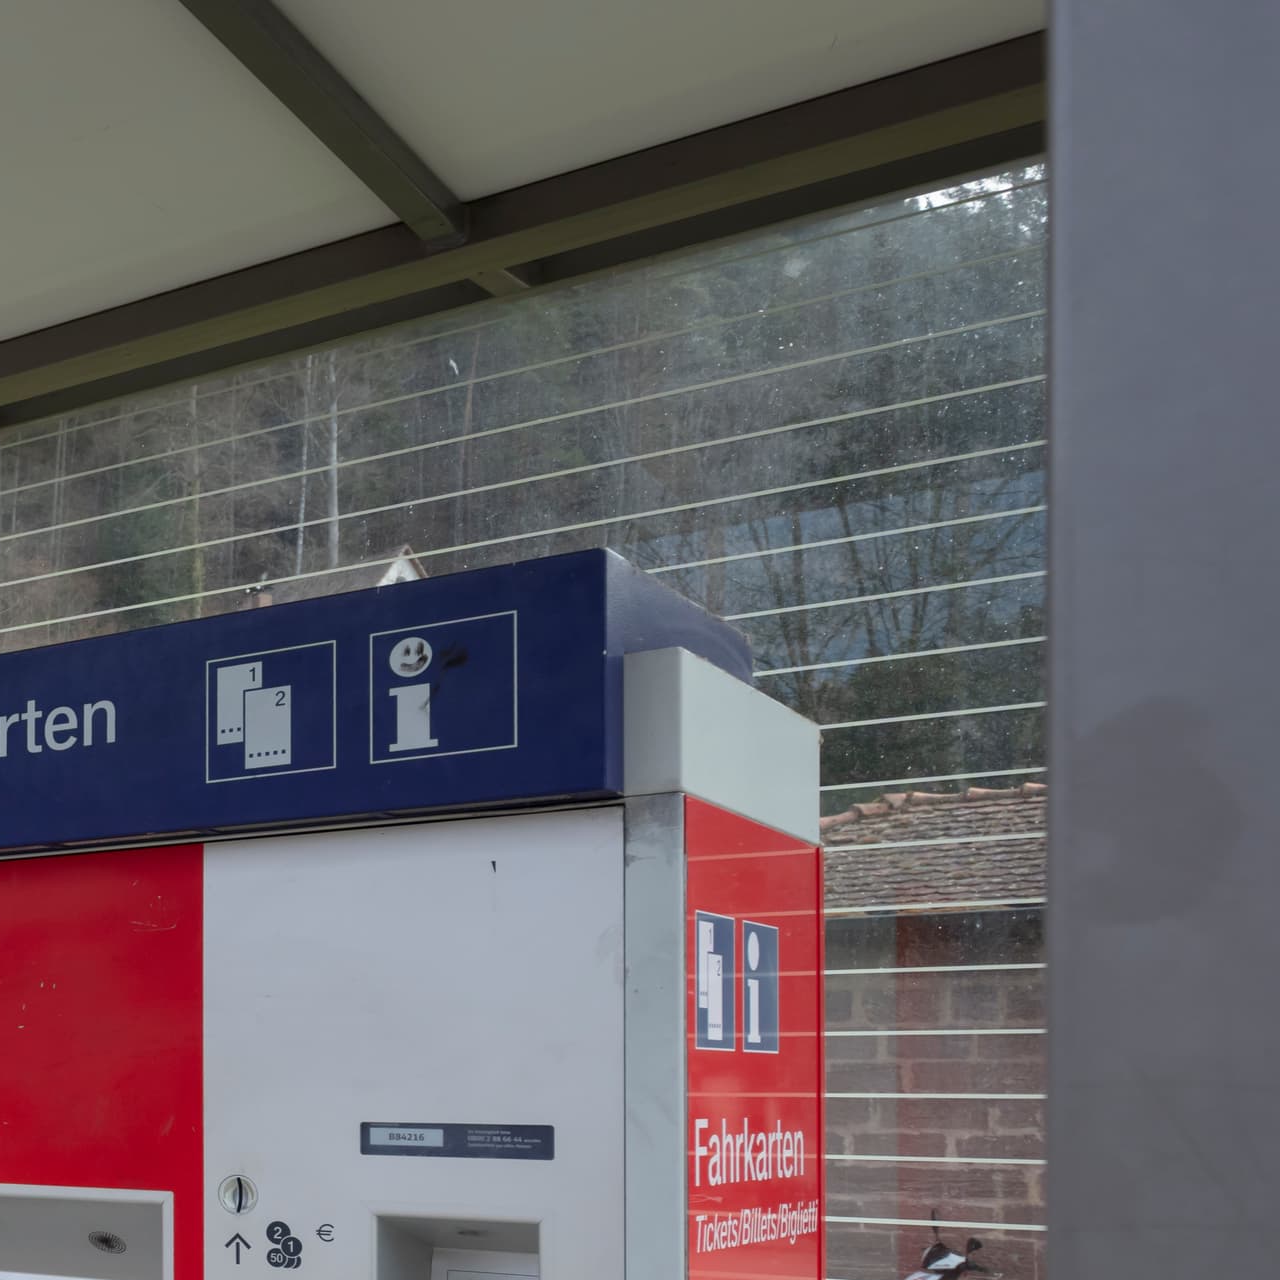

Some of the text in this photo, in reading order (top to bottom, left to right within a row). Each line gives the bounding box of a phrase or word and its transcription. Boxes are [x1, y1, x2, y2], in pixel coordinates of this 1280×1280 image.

[695, 1117, 805, 1187] Fahrkarten
[273, 1226, 283, 1240] 2
[695, 1198, 819, 1254] Tickets/Billets/Biglietti
[270, 1253, 283, 1263] 50
